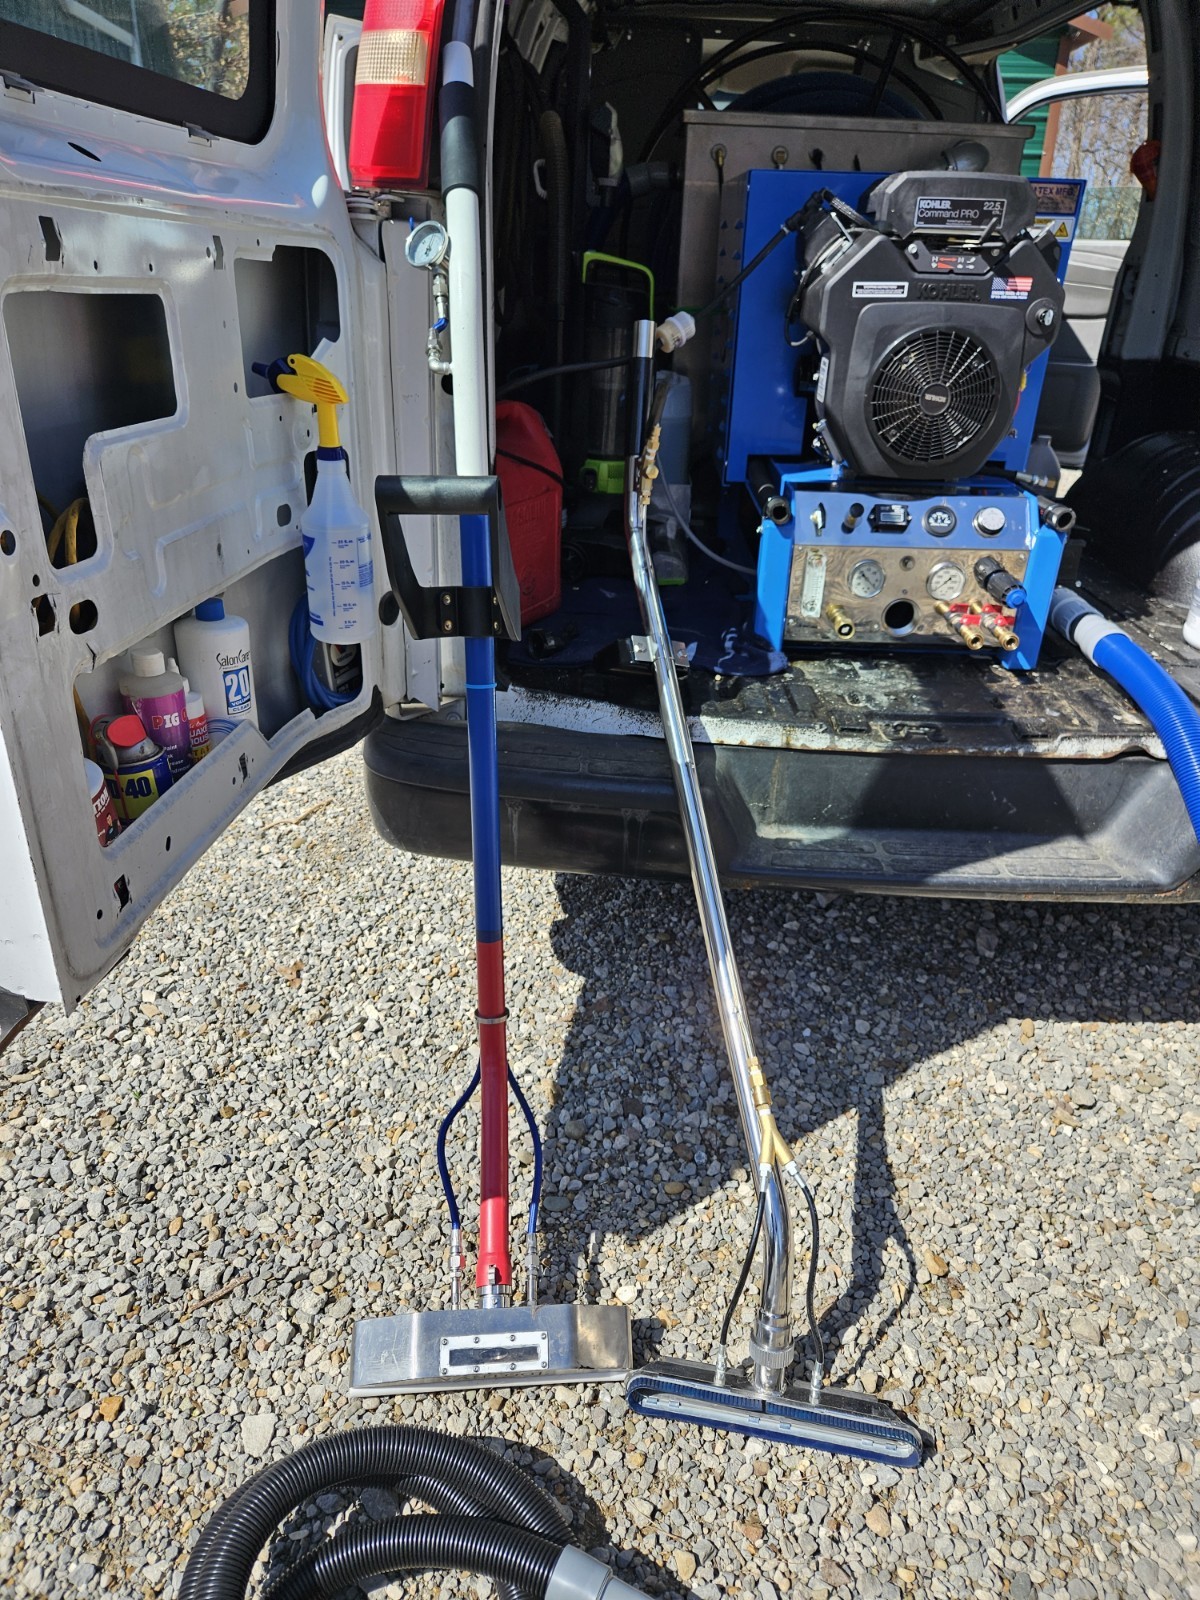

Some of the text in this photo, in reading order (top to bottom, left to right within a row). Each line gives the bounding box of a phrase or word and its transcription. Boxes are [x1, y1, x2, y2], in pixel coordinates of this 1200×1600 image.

[919, 200, 951, 209] KOHLER
[918, 209, 980, 219] Command PRO
[225, 669, 250, 702] 20
[152, 712, 180, 730] PIG
[105, 776, 153, 799] D-40
